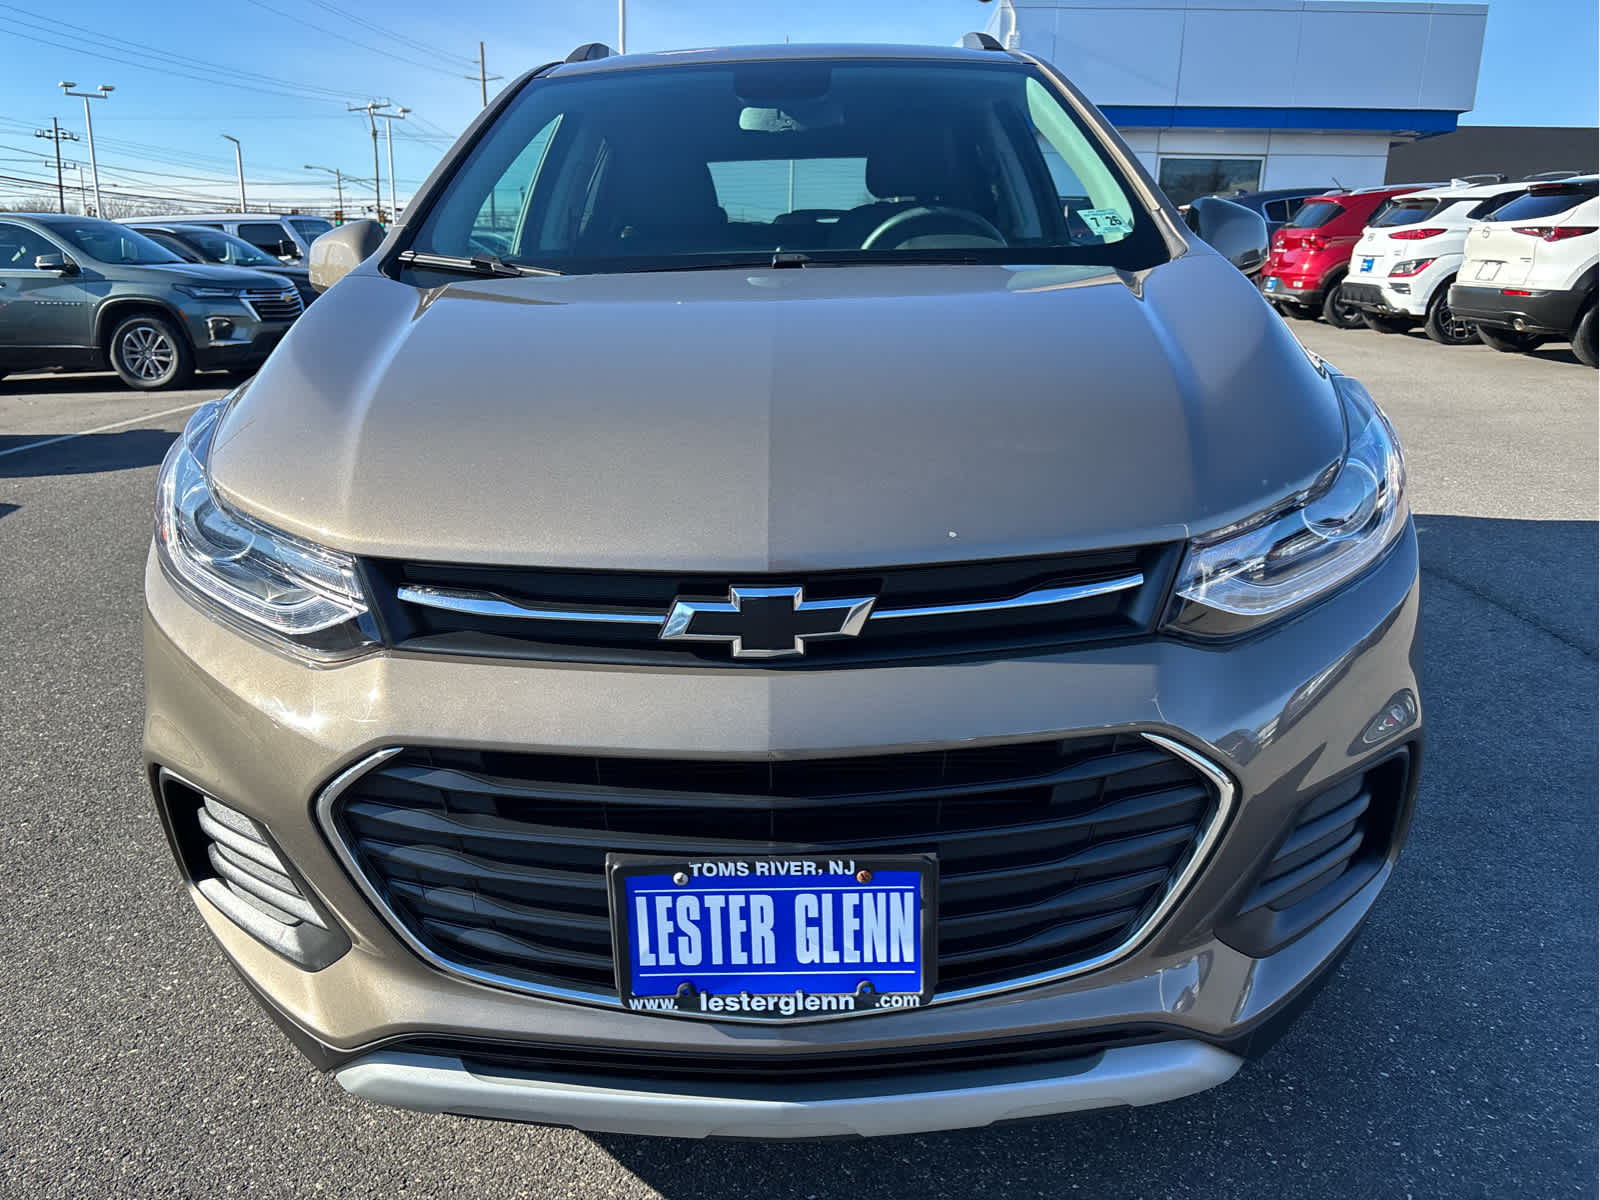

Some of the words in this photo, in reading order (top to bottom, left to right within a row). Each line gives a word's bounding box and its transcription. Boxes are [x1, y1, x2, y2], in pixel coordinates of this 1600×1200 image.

[690, 862, 750, 877] TOMS
[755, 861, 823, 876] RIVER,
[829, 860, 855, 875] NJ
[635, 894, 776, 966] LESTER
[795, 891, 914, 965] GLENN
[629, 998, 679, 1010] www.
[700, 993, 855, 1015] lesterglenn
[875, 994, 920, 1008] .com
